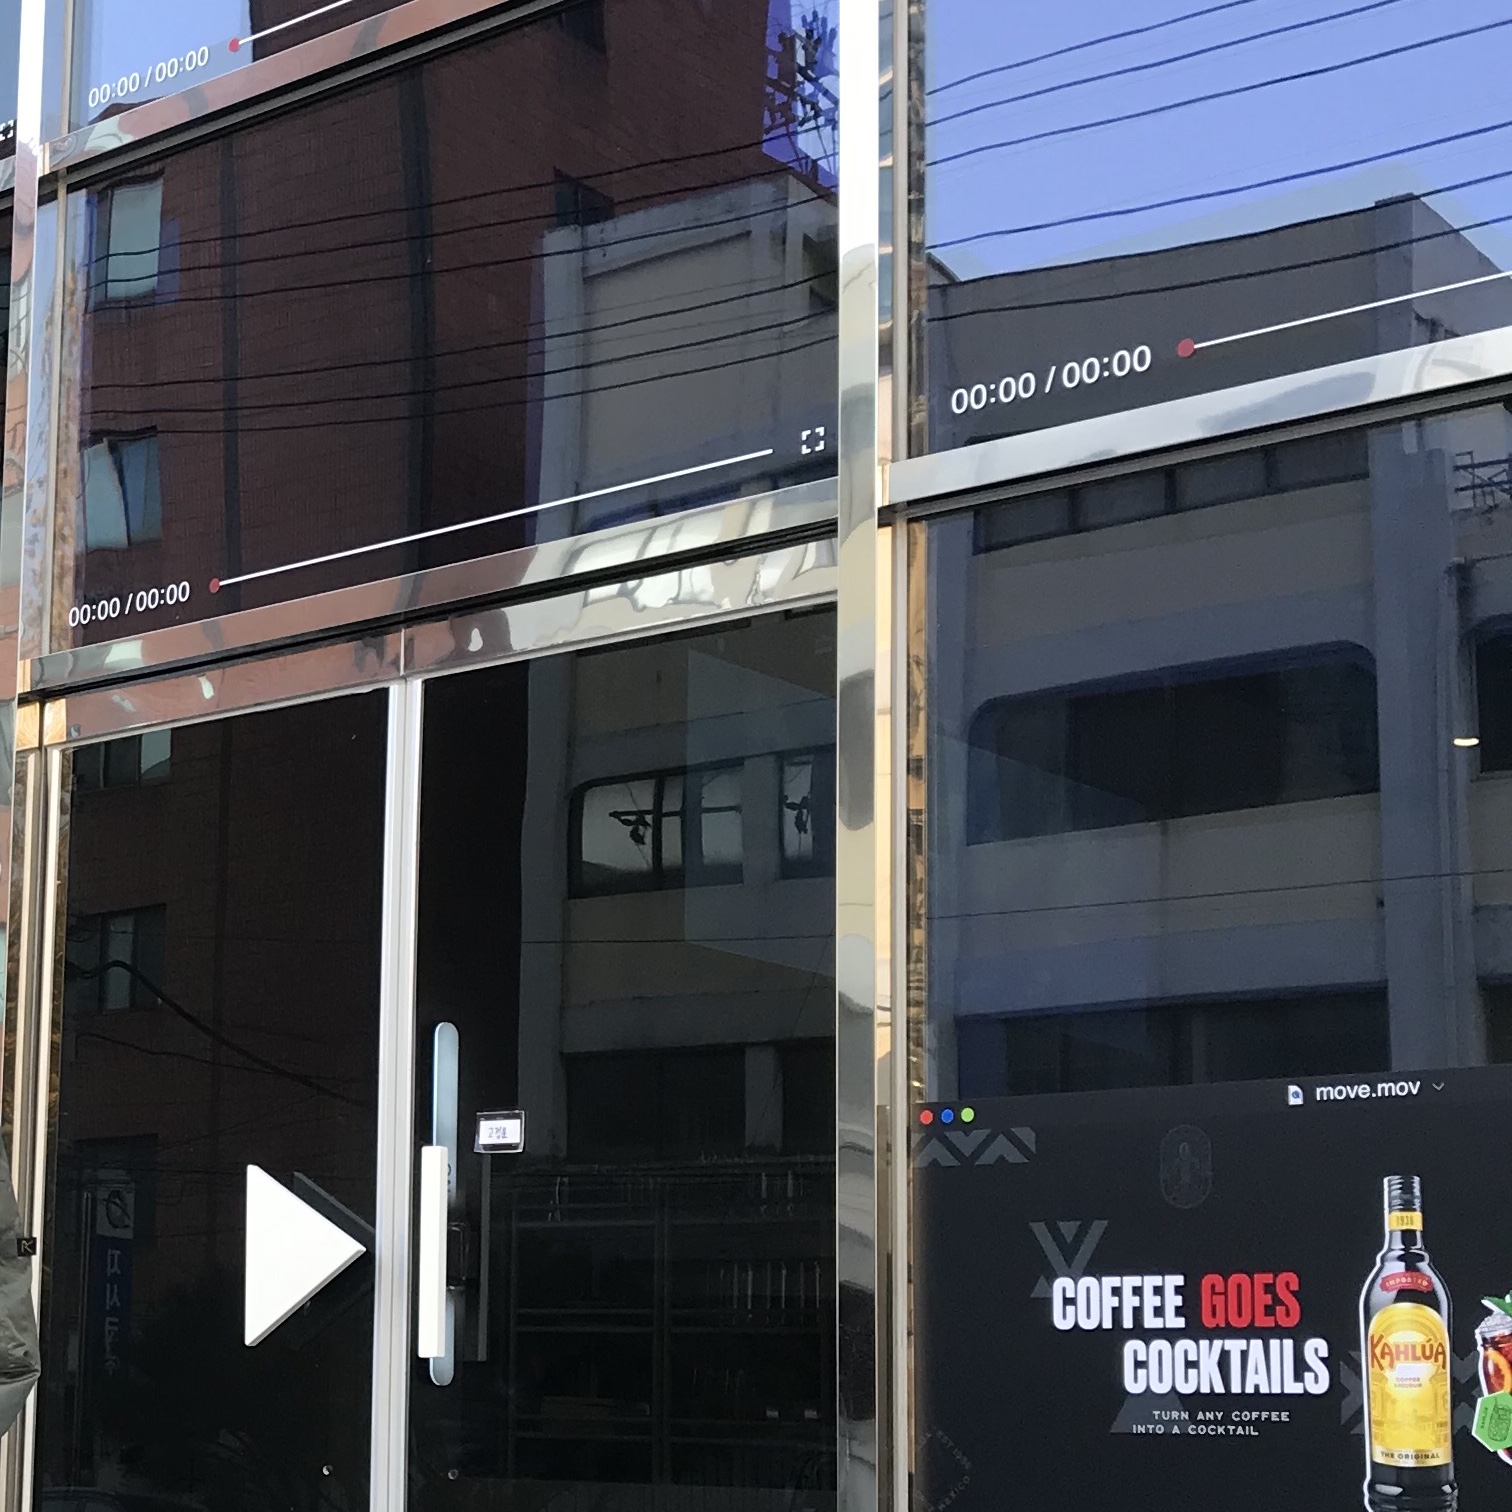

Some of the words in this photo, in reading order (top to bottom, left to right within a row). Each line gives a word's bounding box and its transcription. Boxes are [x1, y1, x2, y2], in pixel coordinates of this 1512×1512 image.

[88, 72, 140, 108] 00:00
[155, 46, 209, 82] 00:00
[951, 372, 1036, 414] 00:00
[1062, 345, 1152, 388] 00:00
[68, 597, 120, 627] 00:00
[135, 580, 190, 612] 00:00
[1315, 1080, 1421, 1101] move.mov
[1052, 1274, 1186, 1331] COFFEE
[1200, 1271, 1301, 1328] GOES
[1123, 1337, 1331, 1395] COCKTAILS
[1370, 1333, 1447, 1371] KAHLÚA
[1132, 1424, 1165, 1435] INTO
[1171, 1425, 1180, 1435] A
[1187, 1425, 1259, 1436] COCKTAIL
[1152, 1410, 1189, 1422] TURN
[1196, 1410, 1224, 1422] ANY
[1231, 1411, 1290, 1422] COFFEE
